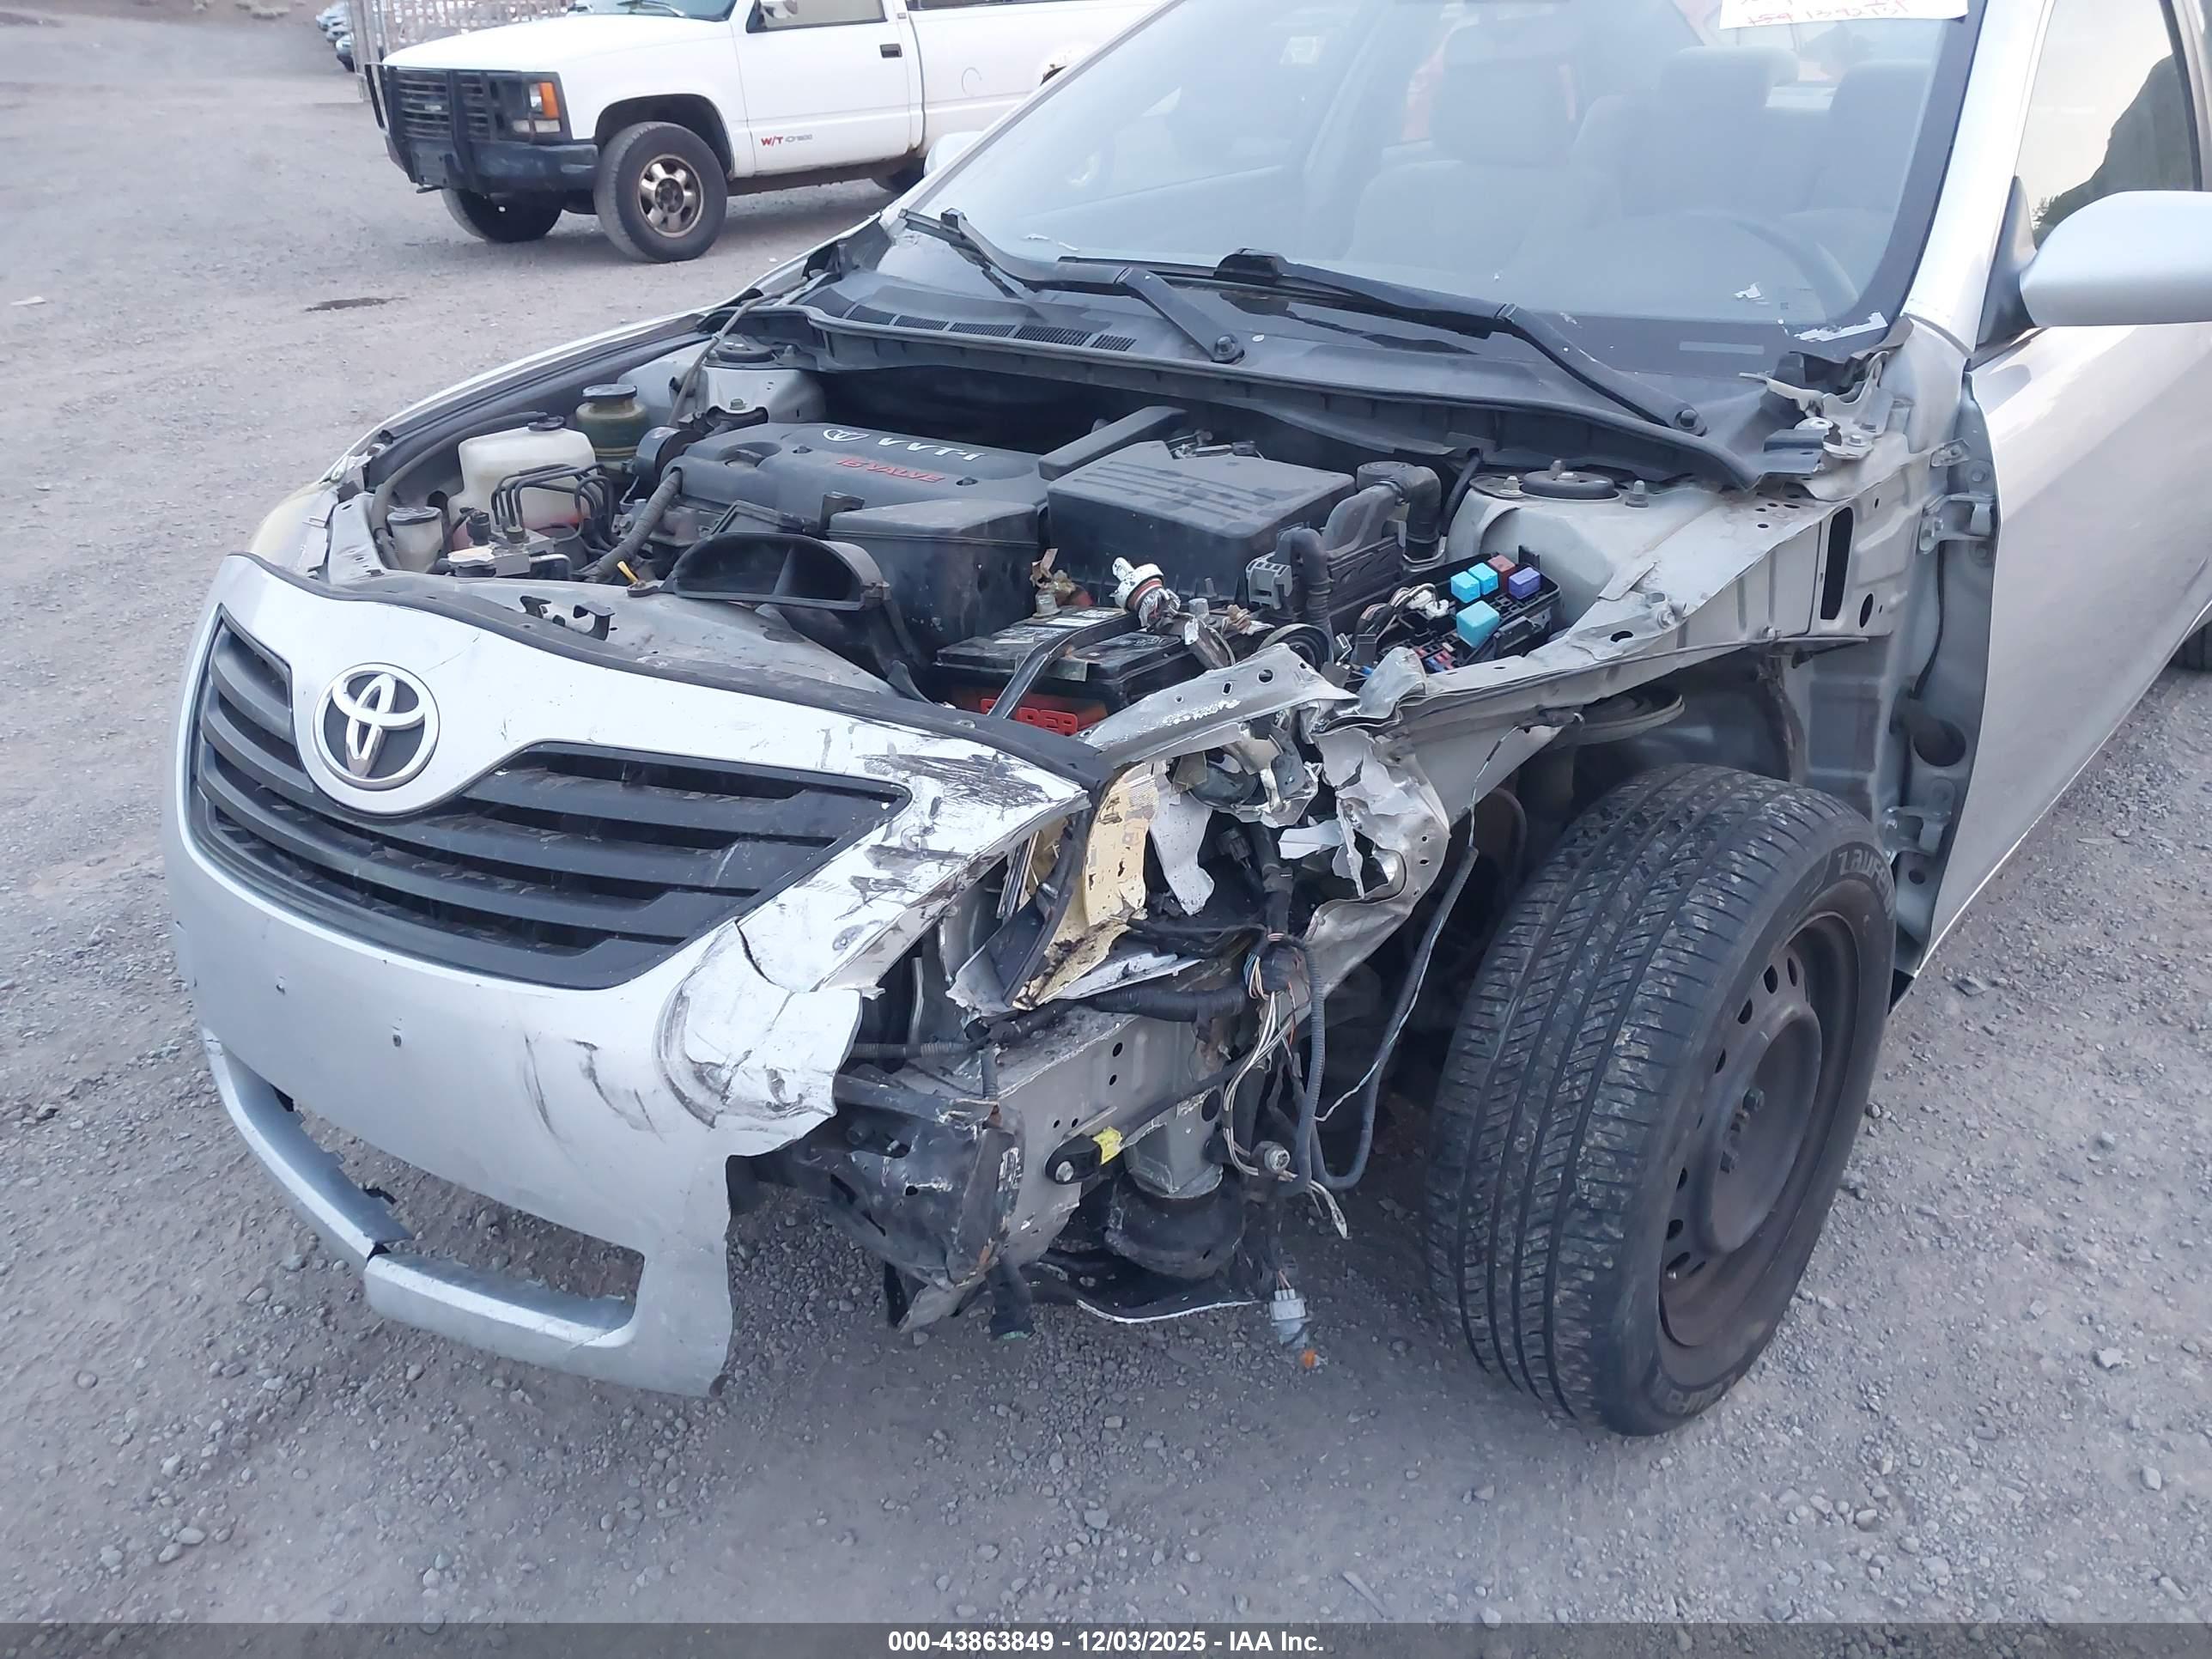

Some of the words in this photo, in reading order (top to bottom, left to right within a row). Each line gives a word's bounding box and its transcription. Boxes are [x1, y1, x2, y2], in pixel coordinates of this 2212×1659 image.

[761, 135, 784, 147] W/T
[836, 458, 868, 469] 16
[866, 465, 946, 483] VALVE
